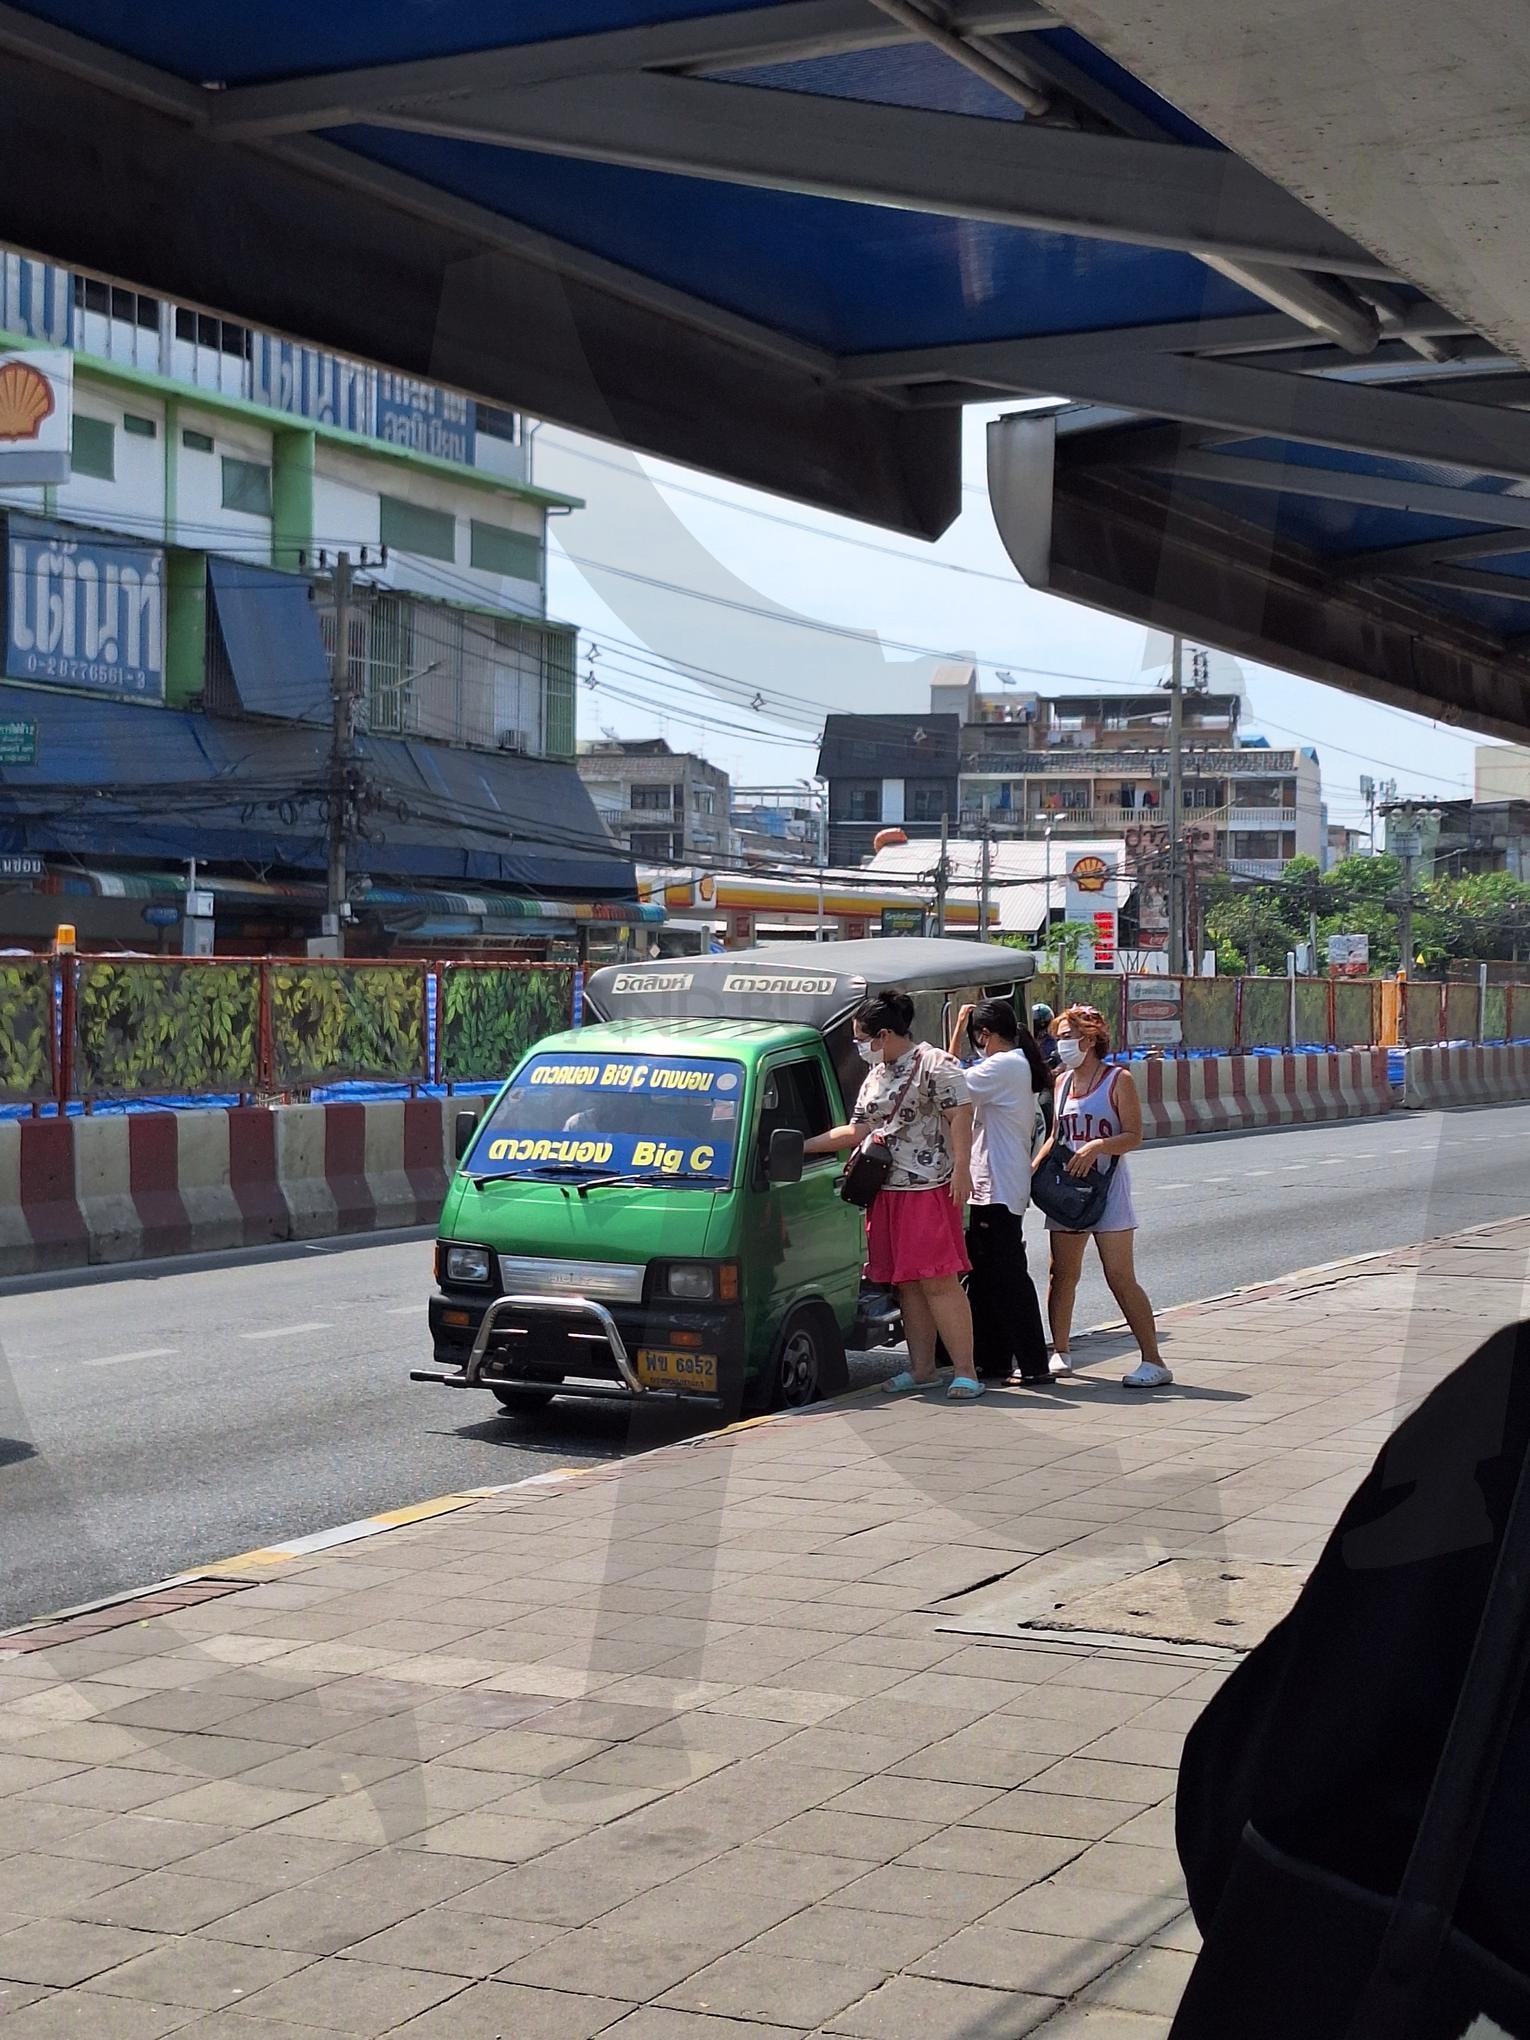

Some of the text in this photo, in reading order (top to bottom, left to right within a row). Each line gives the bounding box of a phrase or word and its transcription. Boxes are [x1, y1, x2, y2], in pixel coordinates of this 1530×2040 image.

[728, 978, 833, 993] ดาวคนอง
[600, 1064, 633, 1086] Big
[633, 1065, 649, 1087] C
[650, 1068, 715, 1091] บางบอน
[489, 1139, 714, 1172] ดาวคะนอง Big C
